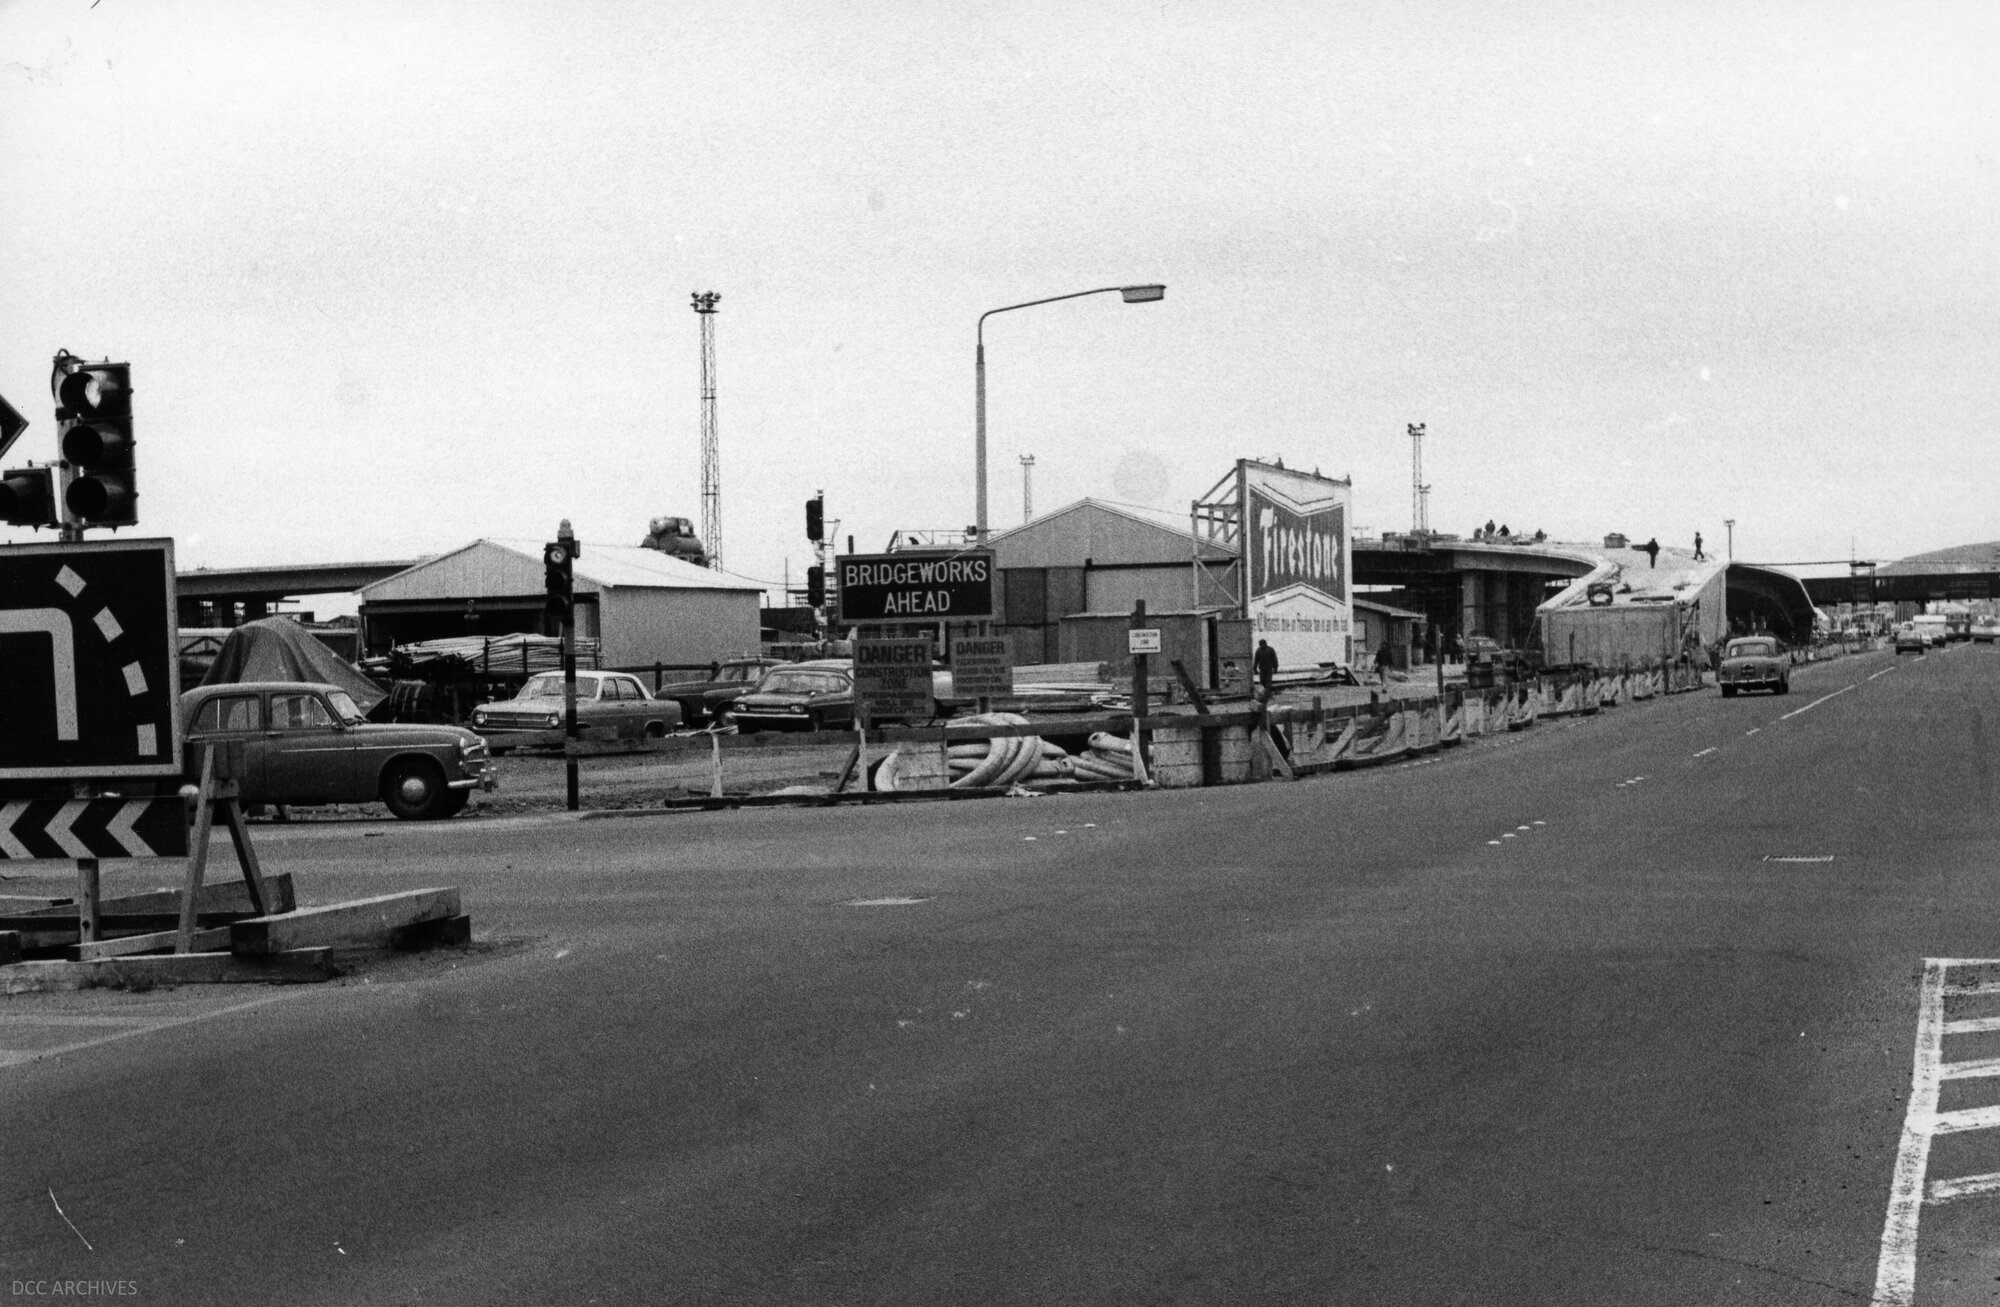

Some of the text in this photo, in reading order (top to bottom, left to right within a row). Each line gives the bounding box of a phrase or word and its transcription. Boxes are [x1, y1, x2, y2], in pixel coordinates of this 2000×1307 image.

[1259, 505, 1338, 588] Firestone
[846, 560, 986, 586] BRIDGEWORKS
[884, 590, 951, 613] AHEAD
[858, 645, 926, 664] DANGER
[956, 641, 1005, 655] DANGER
[855, 666, 931, 679] CONSTRUCTION
[881, 679, 909, 690] ZONE
